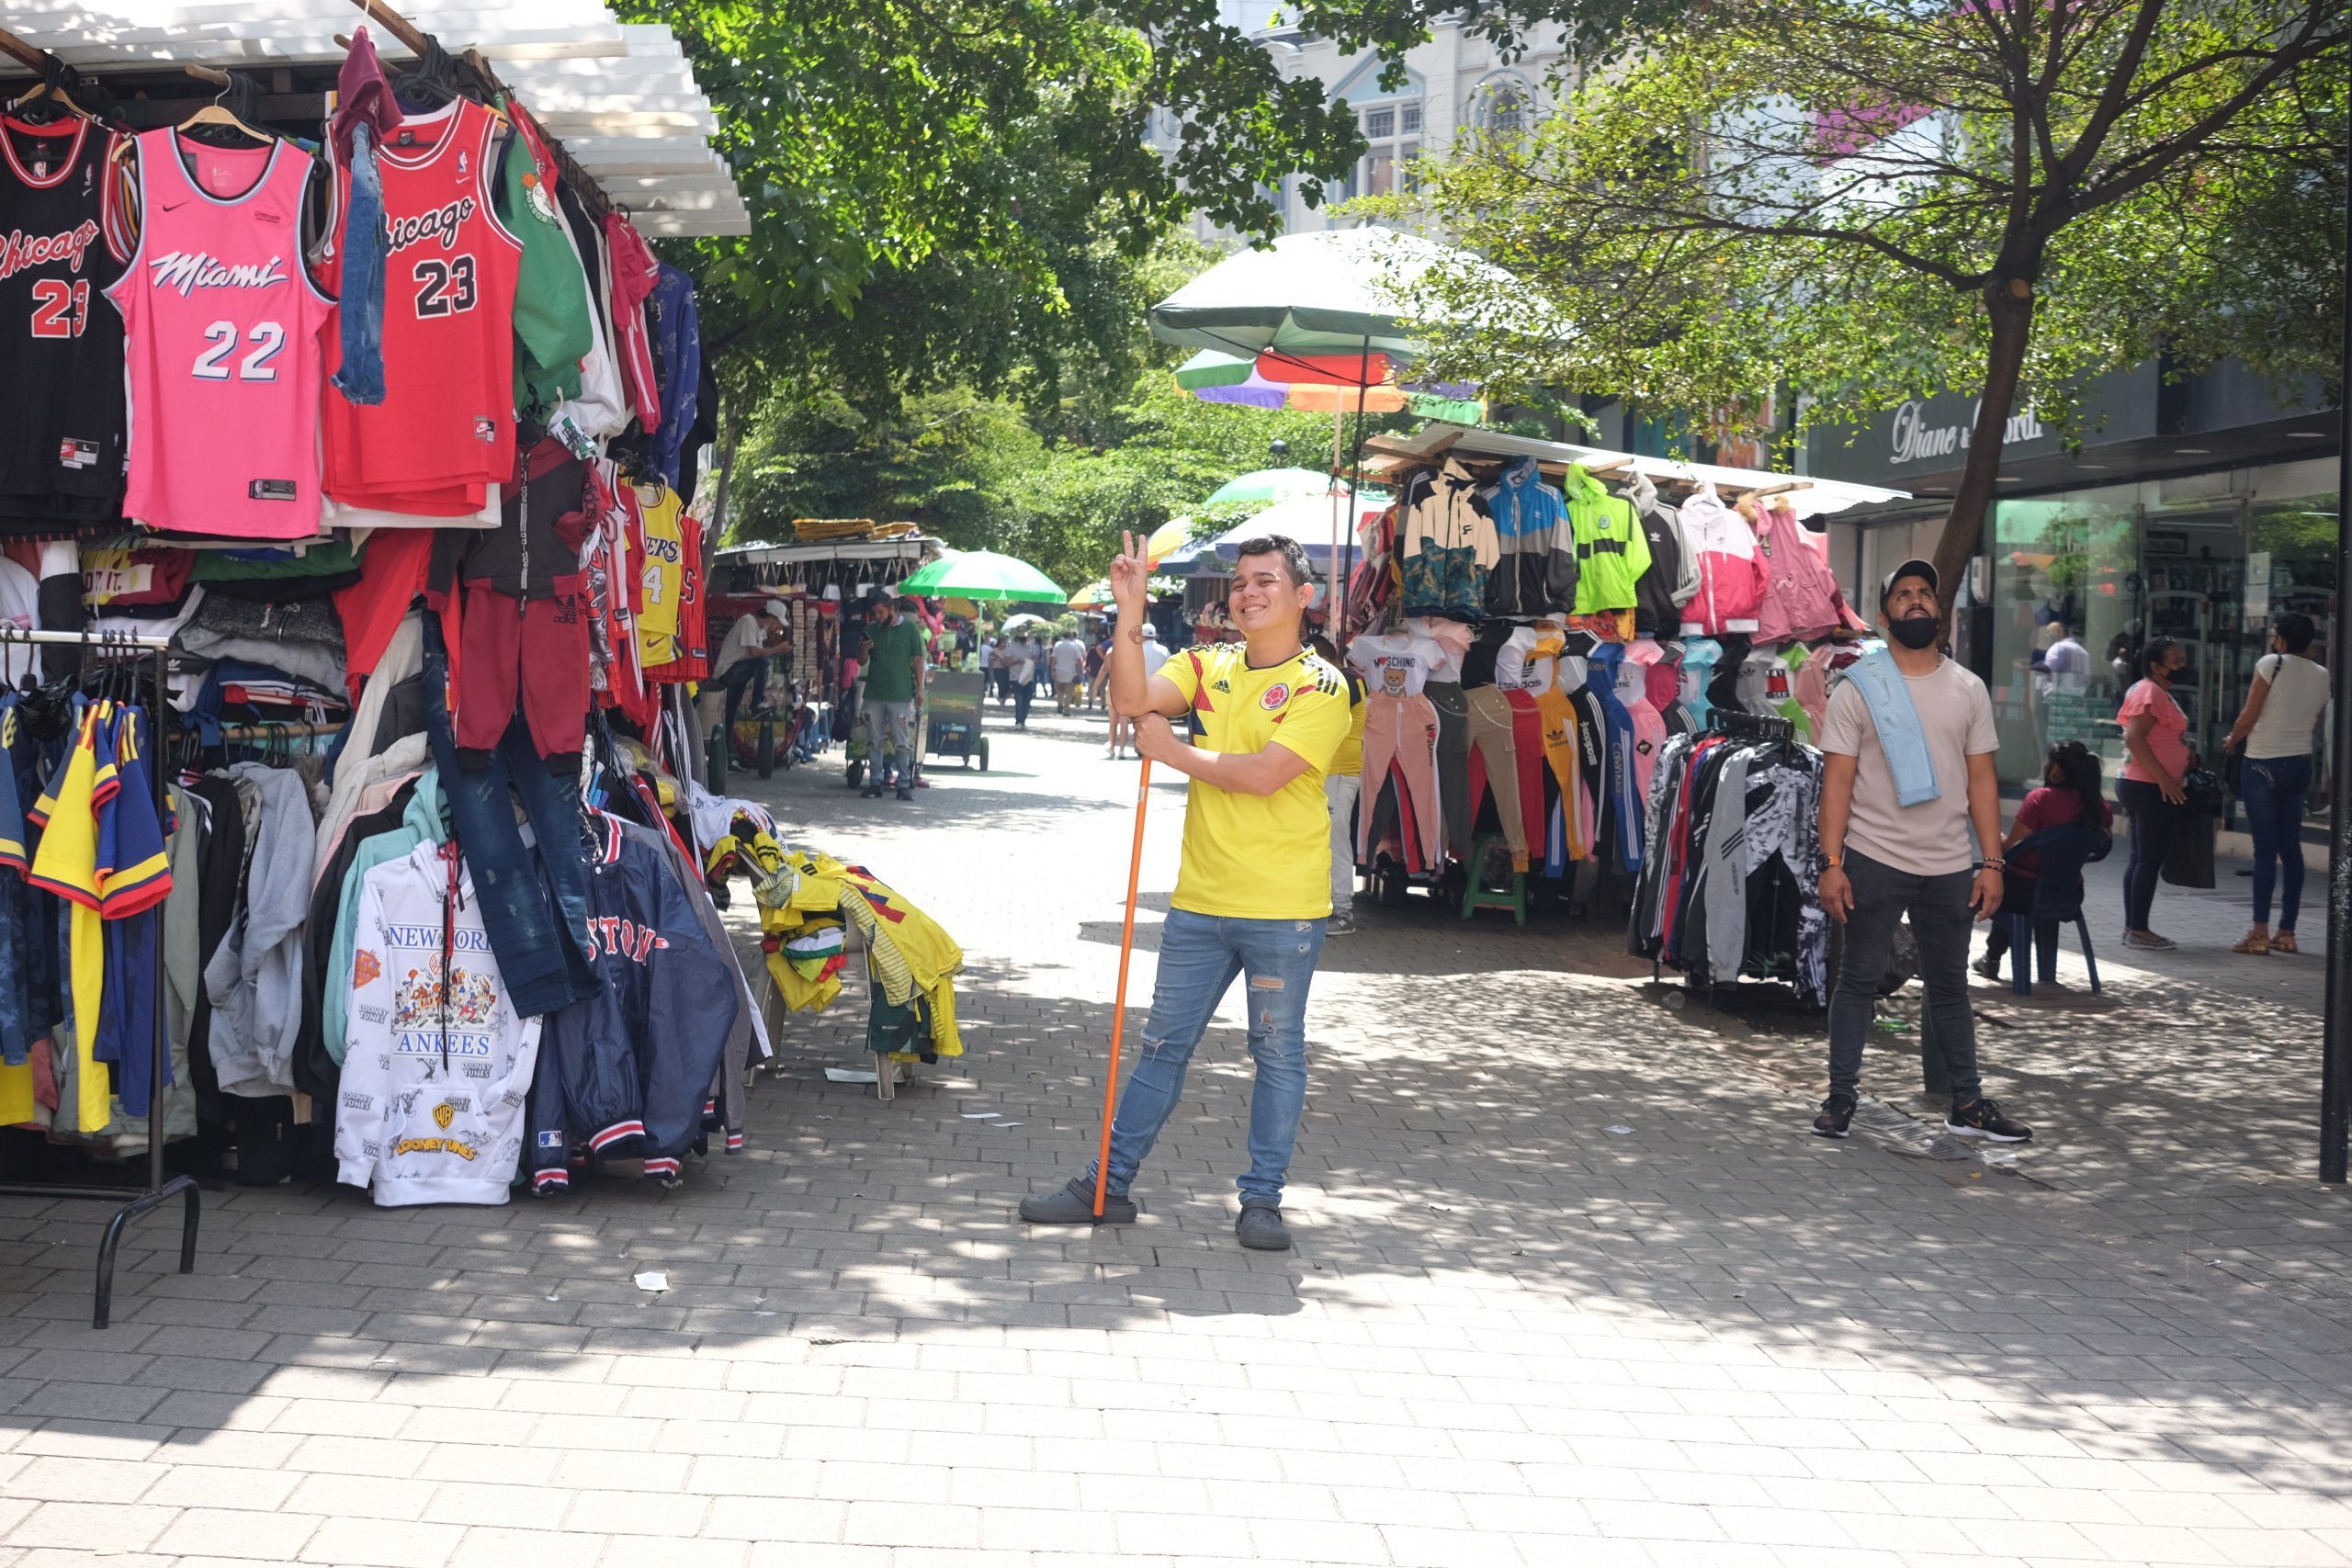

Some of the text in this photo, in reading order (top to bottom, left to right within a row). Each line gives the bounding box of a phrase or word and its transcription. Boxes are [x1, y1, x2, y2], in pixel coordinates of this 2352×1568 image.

[148, 251, 288, 298] Miami
[413, 253, 478, 320] 23
[31, 278, 90, 339] 23
[192, 320, 286, 384] 22
[1889, 400, 1958, 464] Diane
[82, 444, 90, 452] L
[646, 536, 679, 563] ERS
[390, 927, 438, 947] NEW
[359, 1004, 389, 1016] LOONEY
[359, 1012, 386, 1024] TUNES
[461, 1061, 492, 1071] LOONEY
[463, 1069, 490, 1078] TUNES
[343, 1091, 374, 1102] LOONEY
[343, 1100, 371, 1111] TUNES
[397, 1138, 476, 1161] LOONEY TUNES
